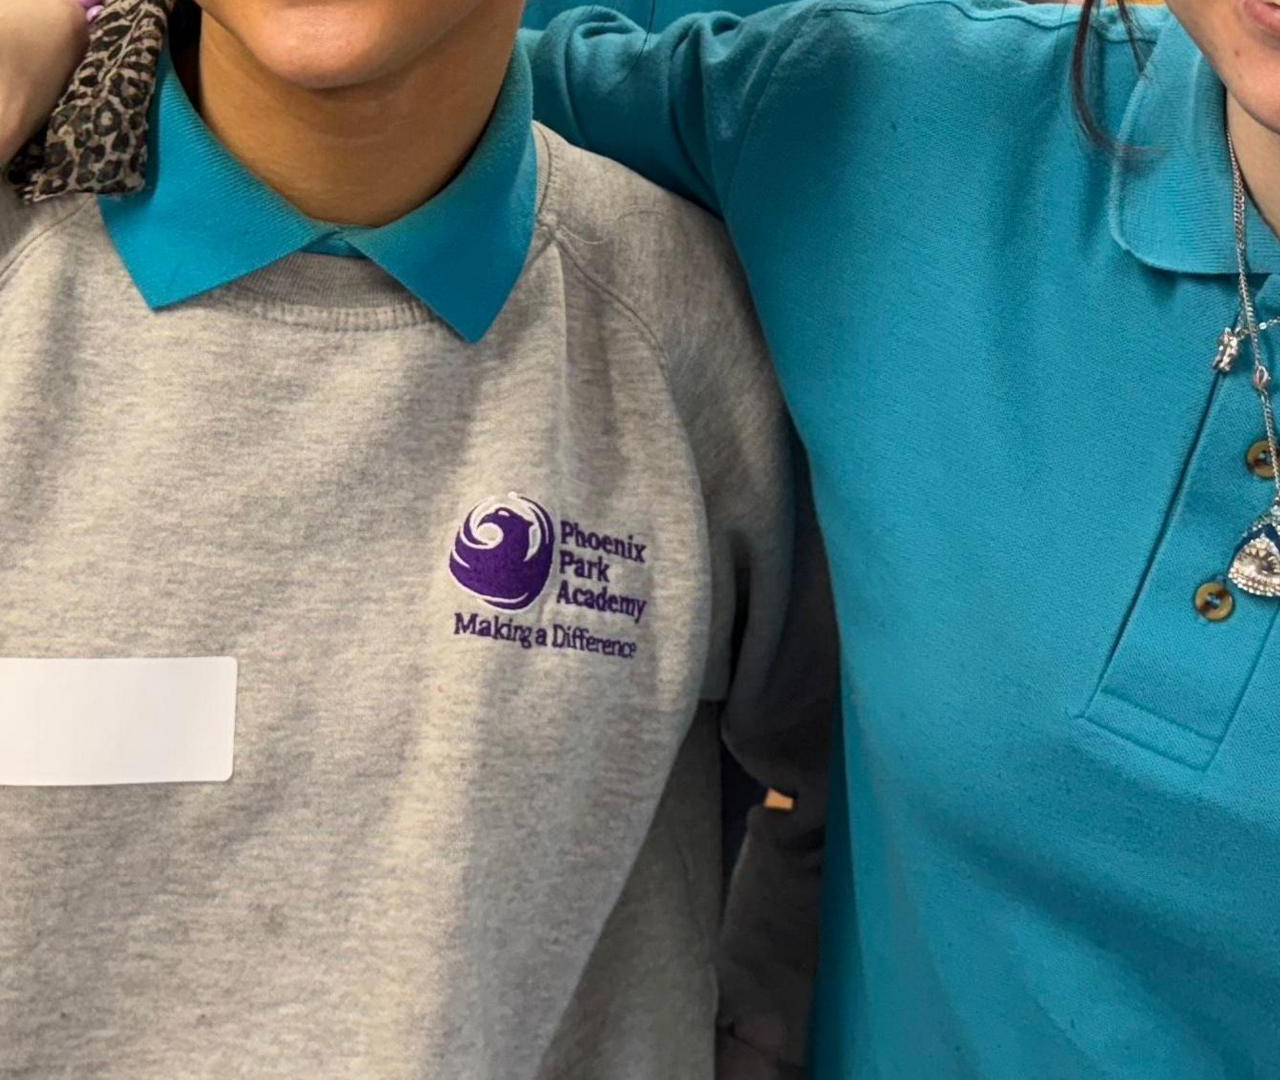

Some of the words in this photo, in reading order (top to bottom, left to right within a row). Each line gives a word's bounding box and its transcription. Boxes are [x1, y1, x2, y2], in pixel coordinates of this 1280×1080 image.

[560, 520, 647, 564] Phoenix
[559, 550, 610, 583] Park
[556, 580, 647, 624] Academy
[453, 612, 532, 650] Making
[535, 628, 548, 647] a
[552, 623, 637, 658] Difference
